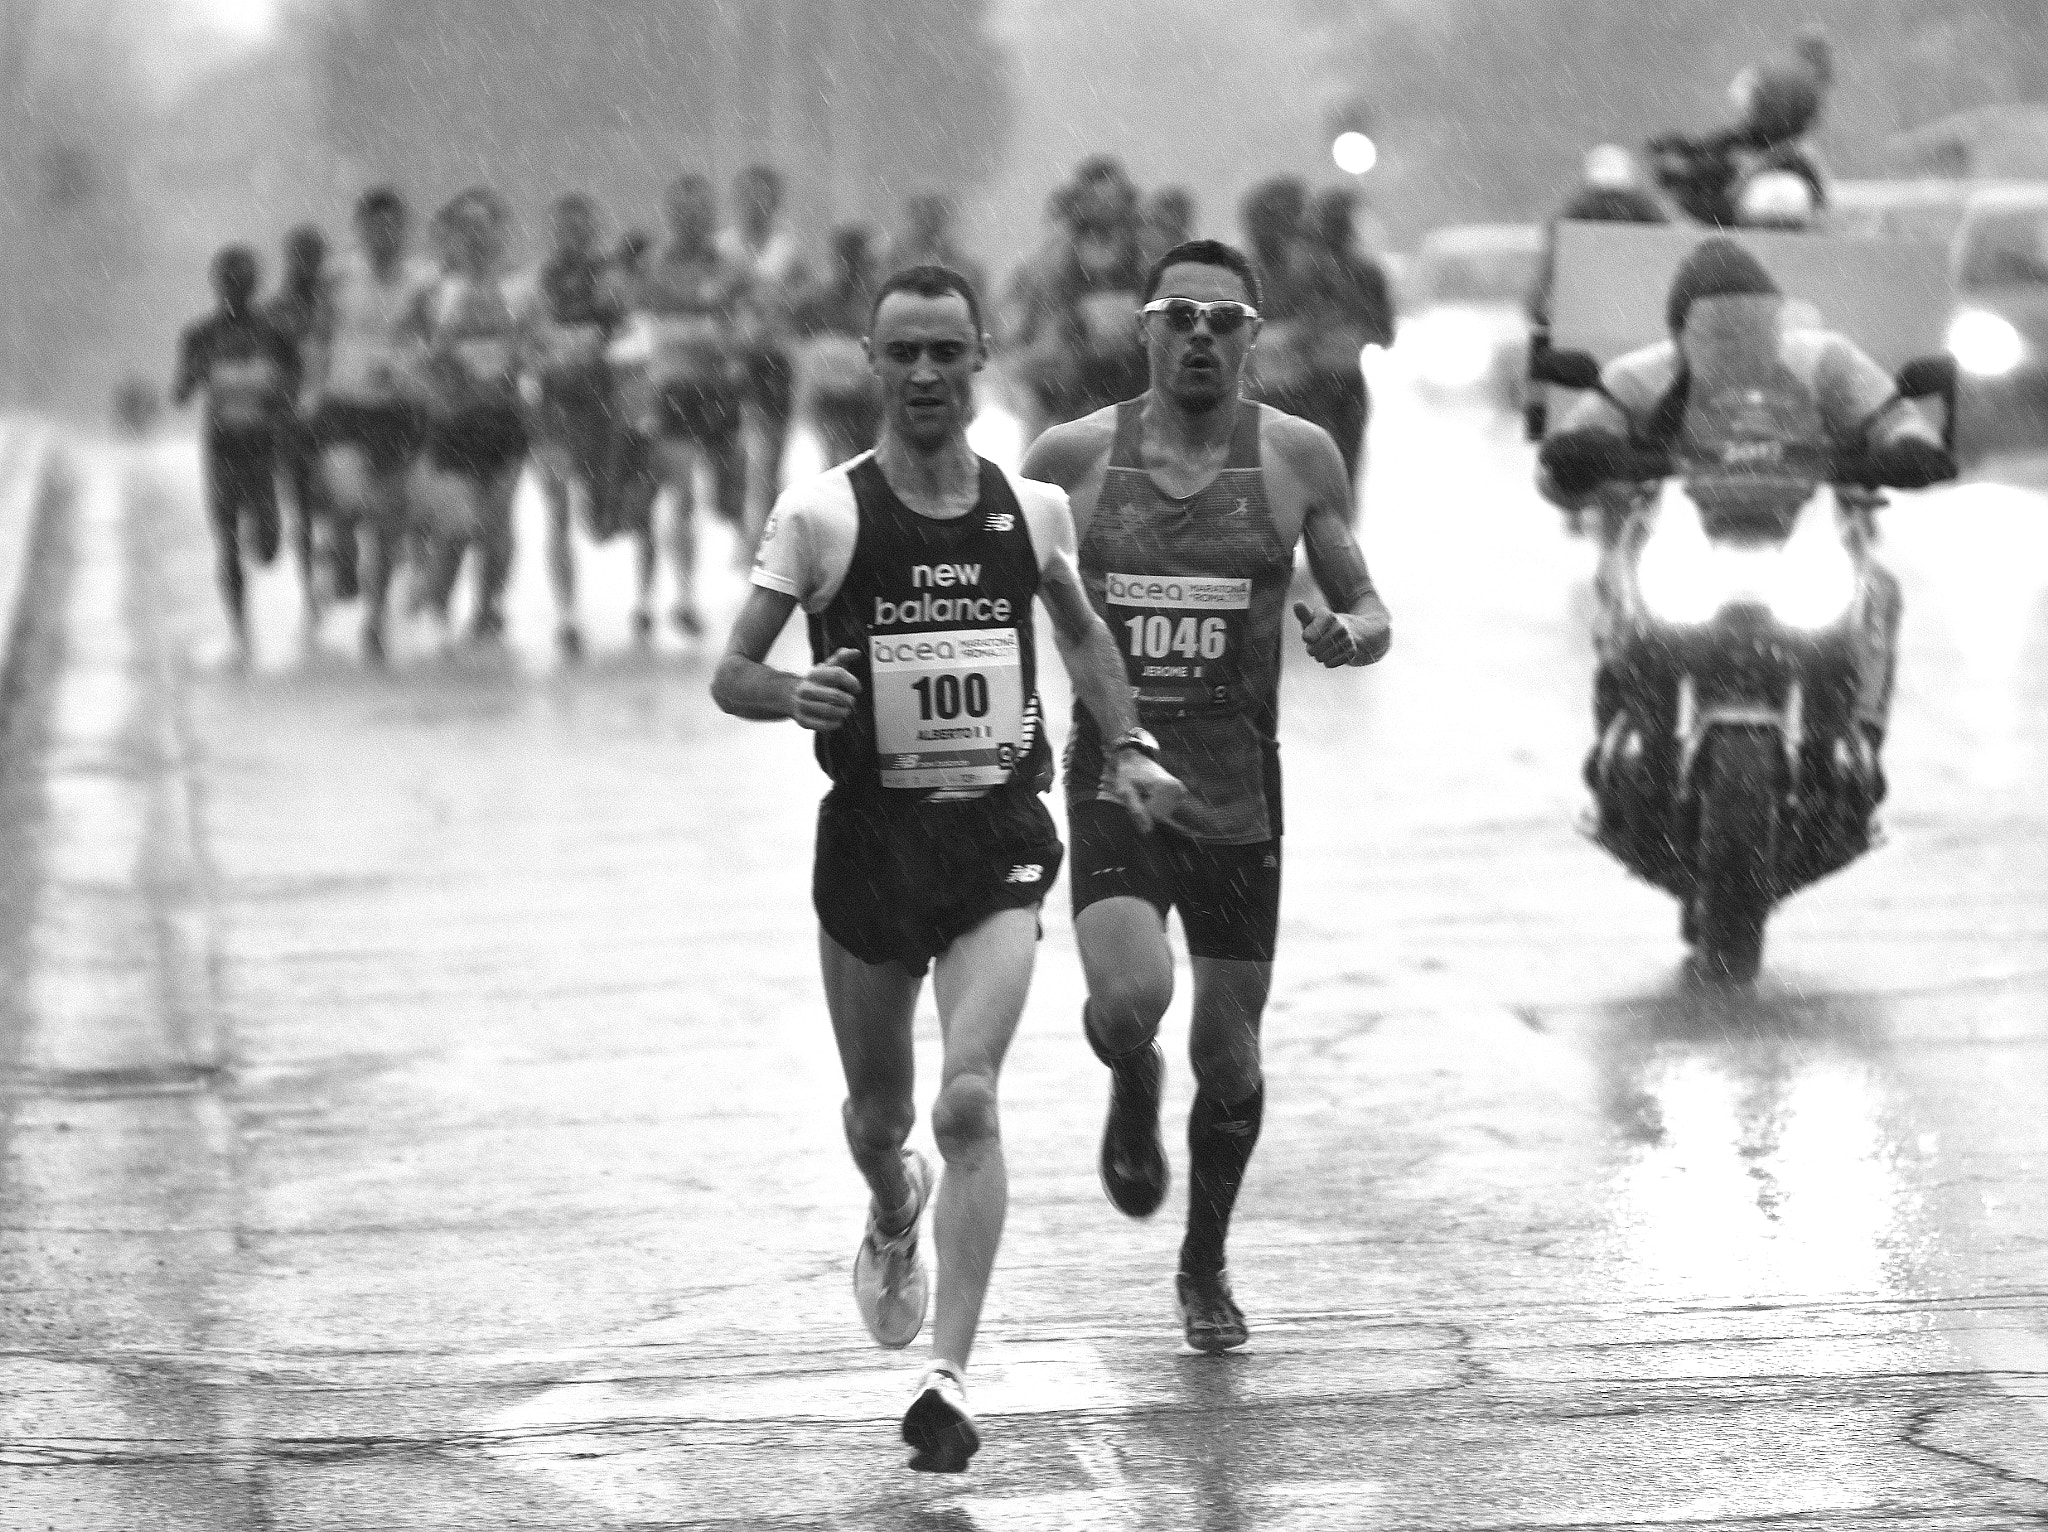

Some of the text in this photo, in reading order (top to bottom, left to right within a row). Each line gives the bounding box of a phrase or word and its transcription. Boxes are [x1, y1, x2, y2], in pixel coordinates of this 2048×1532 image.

[912, 563, 982, 588] new
[1109, 576, 1183, 601] acea
[874, 593, 1013, 625] balance
[1125, 615, 1228, 660] 1046
[874, 639, 956, 663] acea
[1141, 665, 1189, 678] JEROME
[911, 672, 989, 721] 100
[916, 727, 974, 741] ALBERTO
